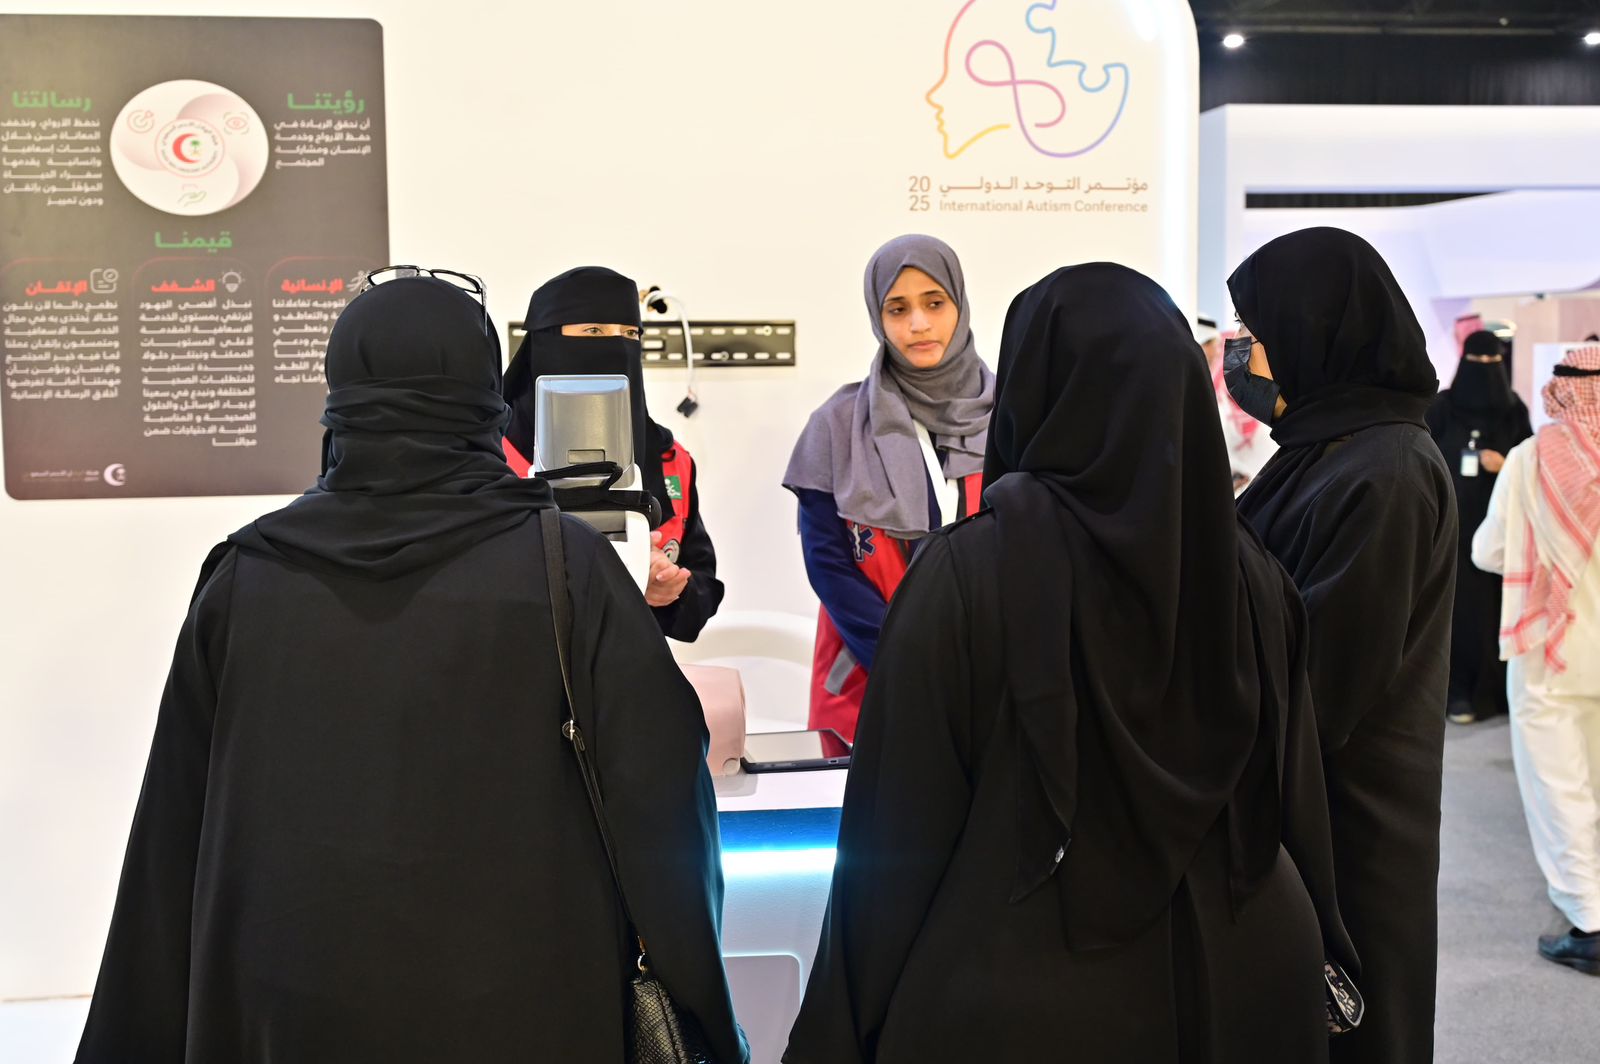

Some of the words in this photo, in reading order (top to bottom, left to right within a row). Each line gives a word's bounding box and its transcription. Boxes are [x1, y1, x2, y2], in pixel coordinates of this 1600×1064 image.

[12, 90, 92, 112] رسالتنا
[288, 89, 365, 115] رؤيتنا
[274, 120, 299, 130] في
[34, 132, 58, 142] من
[908, 176, 930, 192] 20
[940, 176, 1018, 197] الدولي
[1024, 176, 1080, 194] التوحد
[1084, 177, 1148, 194] مؤتمر
[909, 195, 930, 212] 25
[940, 200, 1023, 212] International
[1026, 200, 1072, 212] Autism
[1075, 200, 1148, 212] Conference
[154, 231, 232, 253] قيمنا
[25, 280, 88, 296] الإتقان
[151, 278, 217, 293] الشغف
[281, 278, 344, 295] الإنسانية
[28, 314, 46, 326] في
[171, 388, 190, 400] في
